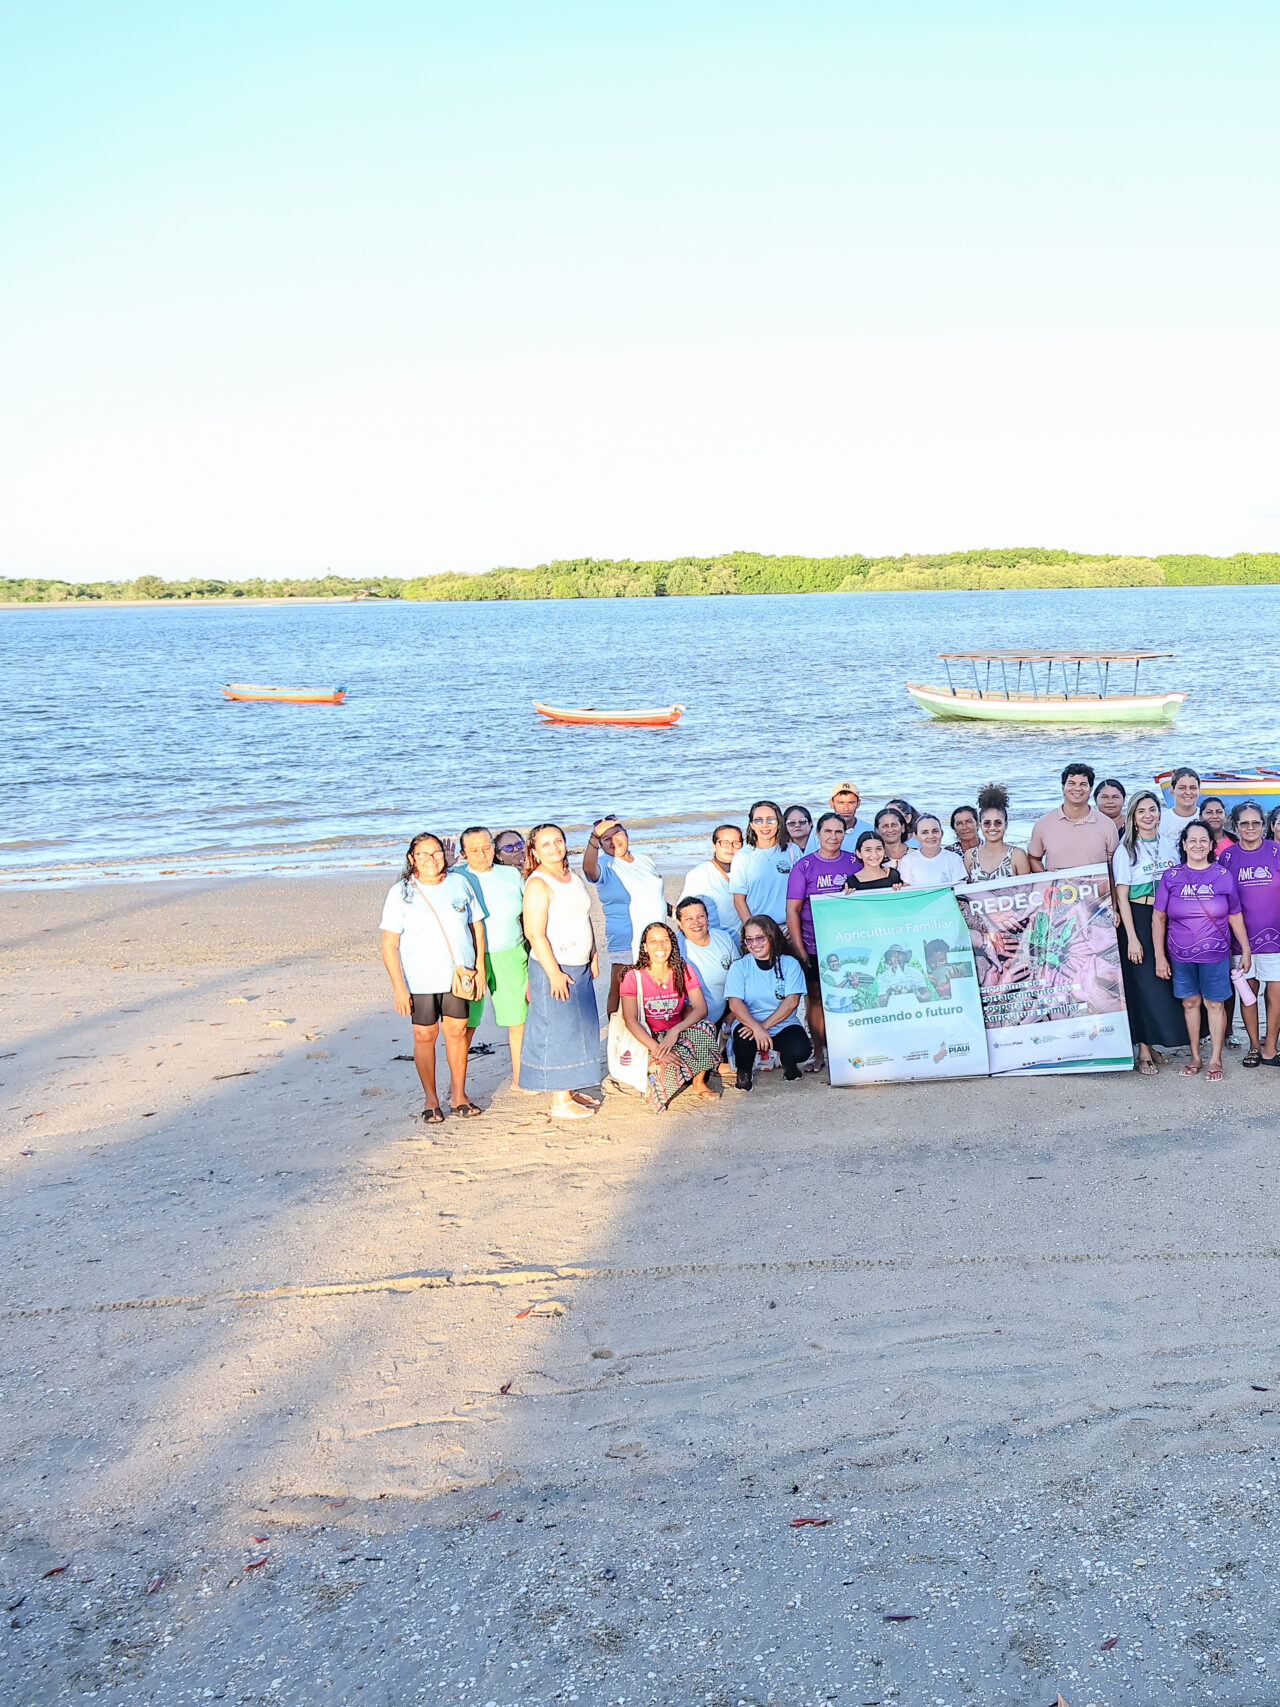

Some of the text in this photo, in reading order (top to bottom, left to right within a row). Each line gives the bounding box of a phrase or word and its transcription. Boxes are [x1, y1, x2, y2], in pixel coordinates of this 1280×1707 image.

[968, 883, 1100, 916] REDECOOPI
[835, 919, 953, 943] Agricultura Familiar
[848, 1004, 964, 1027] semeando o futuro
[1040, 1003, 1080, 1015] Familiar
